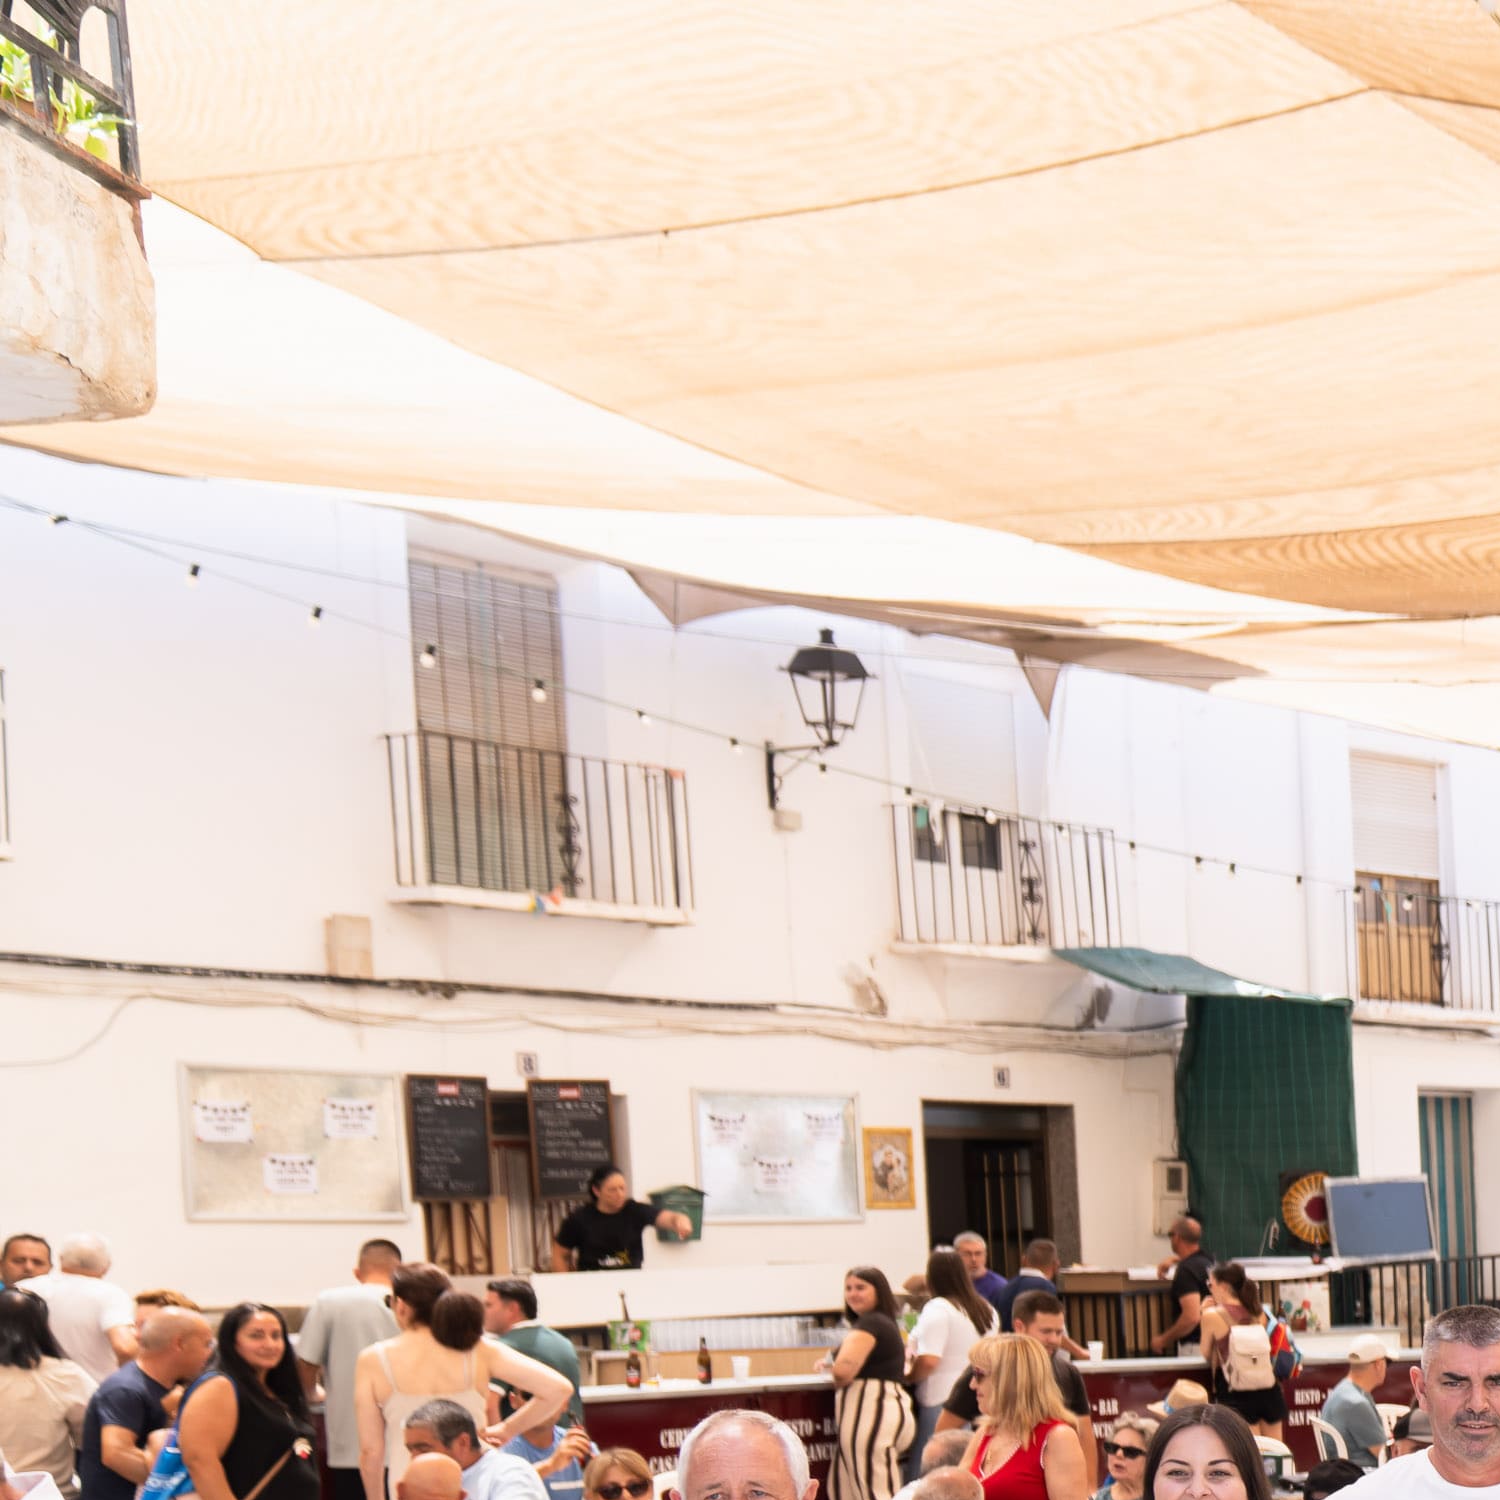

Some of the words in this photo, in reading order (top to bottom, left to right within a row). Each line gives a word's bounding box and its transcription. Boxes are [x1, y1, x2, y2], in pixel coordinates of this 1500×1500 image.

[1294, 1388, 1321, 1406] RESTO
[1098, 1398, 1119, 1416] BAR
[1288, 1409, 1305, 1427] SAN
